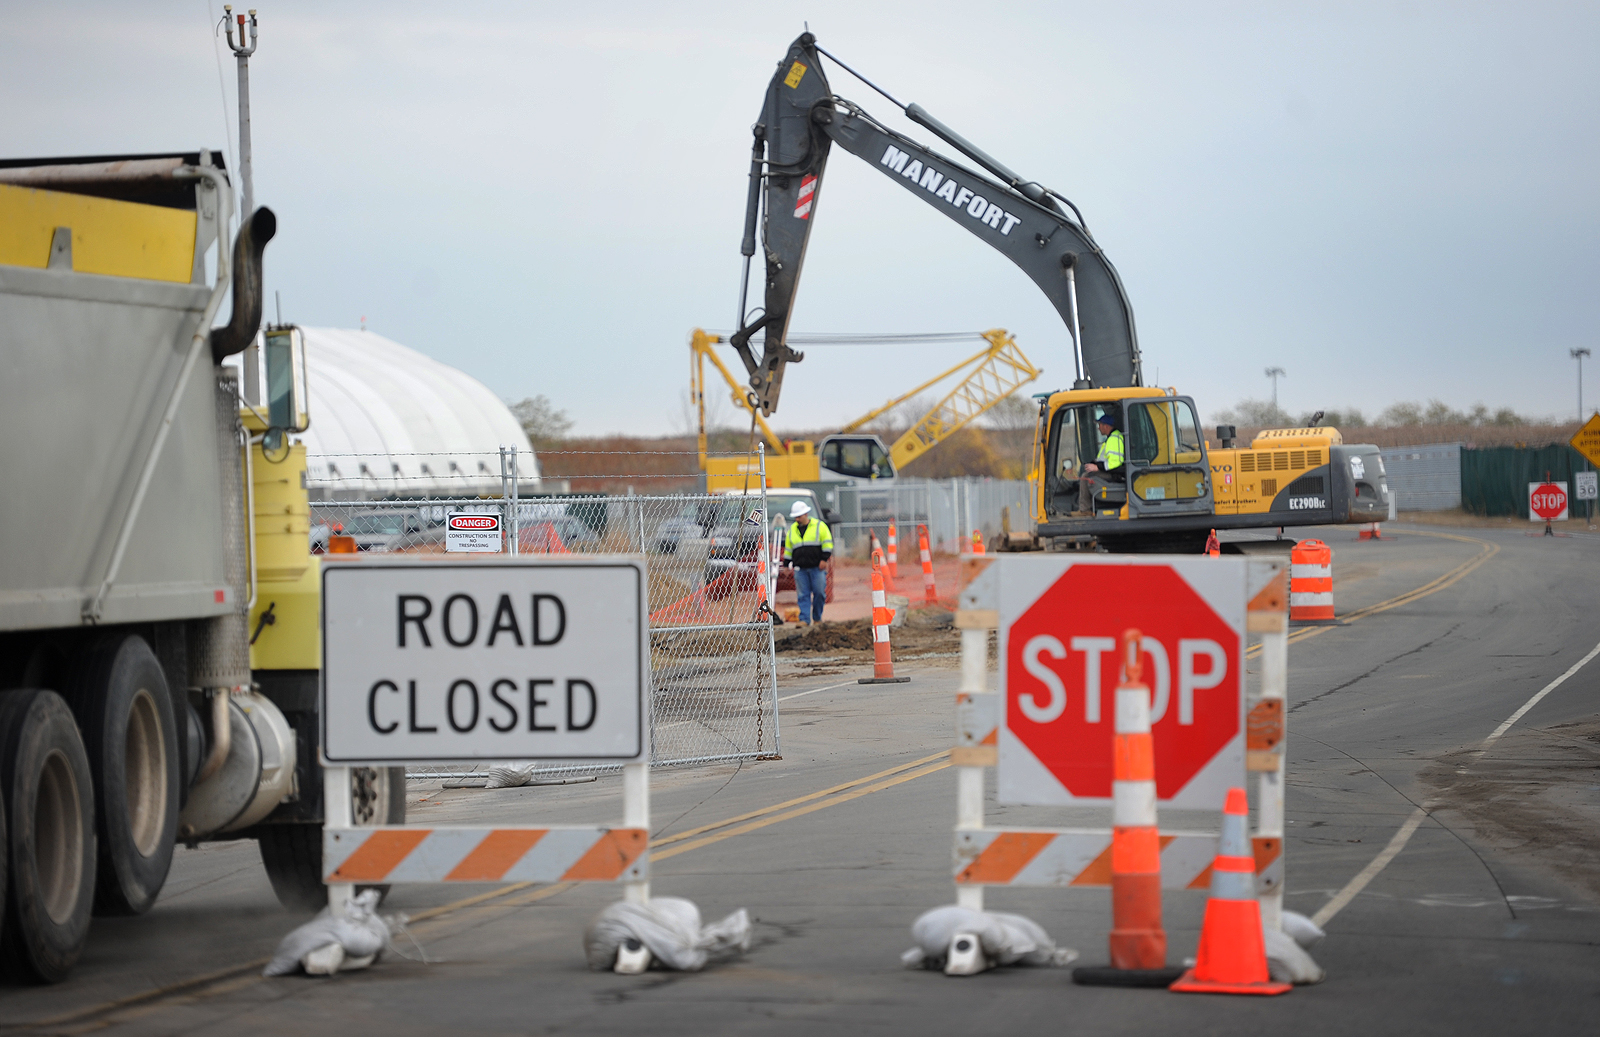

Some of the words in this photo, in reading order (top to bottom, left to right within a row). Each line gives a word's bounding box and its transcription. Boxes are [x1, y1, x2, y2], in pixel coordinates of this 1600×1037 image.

[880, 144, 1022, 236] MANAFORT
[456, 519, 492, 527] DANGER
[1533, 493, 1565, 510] STOP
[396, 593, 567, 648] ROAD
[367, 678, 598, 735] CLOSED
[1017, 633, 1228, 726] STOP
